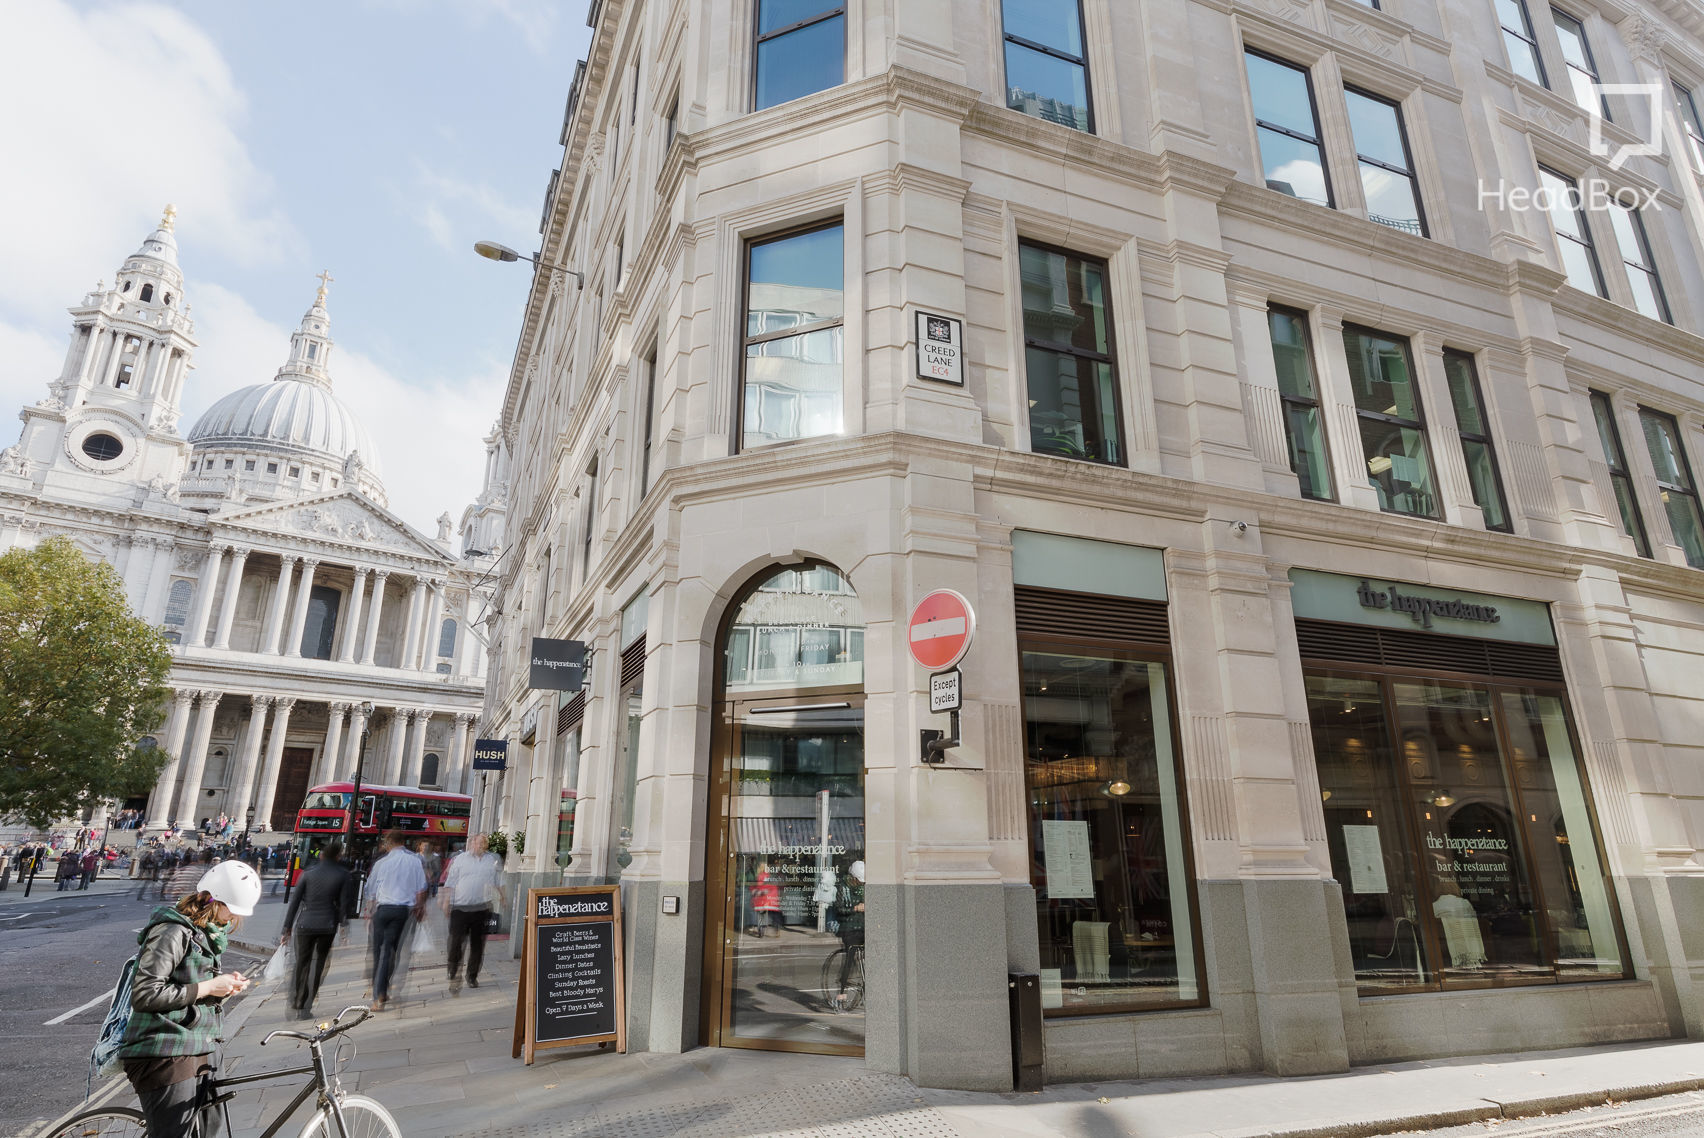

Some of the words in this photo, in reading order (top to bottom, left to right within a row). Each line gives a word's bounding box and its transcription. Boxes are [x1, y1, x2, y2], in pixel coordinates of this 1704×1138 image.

[924, 344, 956, 357] CREED
[927, 354, 953, 367] LANE
[932, 365, 949, 376] EC4
[1357, 580, 1388, 608] the
[1387, 584, 1500, 628] happenstance
[800, 643, 830, 652] FRIDAY
[532, 657, 543, 666] the
[543, 658, 581, 669] happenstance
[933, 677, 956, 691] Except
[934, 692, 955, 706] cycles
[474, 750, 505, 760] HUSH
[332, 818, 341, 827] 15
[760, 840, 777, 855] the
[1426, 830, 1444, 849] the
[1443, 832, 1509, 858] happenstance
[764, 863, 781, 874] bar
[781, 864, 790, 874] &
[1436, 859, 1452, 872] bar
[1453, 860, 1462, 872] &
[1463, 861, 1508, 872] restaurant
[541, 896, 558, 907] the
[538, 901, 609, 918] happenstance
[550, 944, 575, 953] Beautiful
[557, 953, 571, 961] Lazy
[572, 952, 595, 960] Lunches
[547, 971, 573, 979] Clinking
[574, 968, 602, 977] Cocktails
[554, 980, 578, 988] Sunday
[578, 978, 596, 986] Roasts
[563, 988, 585, 997] Bloody
[585, 987, 604, 996] Marys
[545, 1006, 561, 1015] Open
[568, 1003, 583, 1012] Days
[587, 1001, 604, 1009] Week
